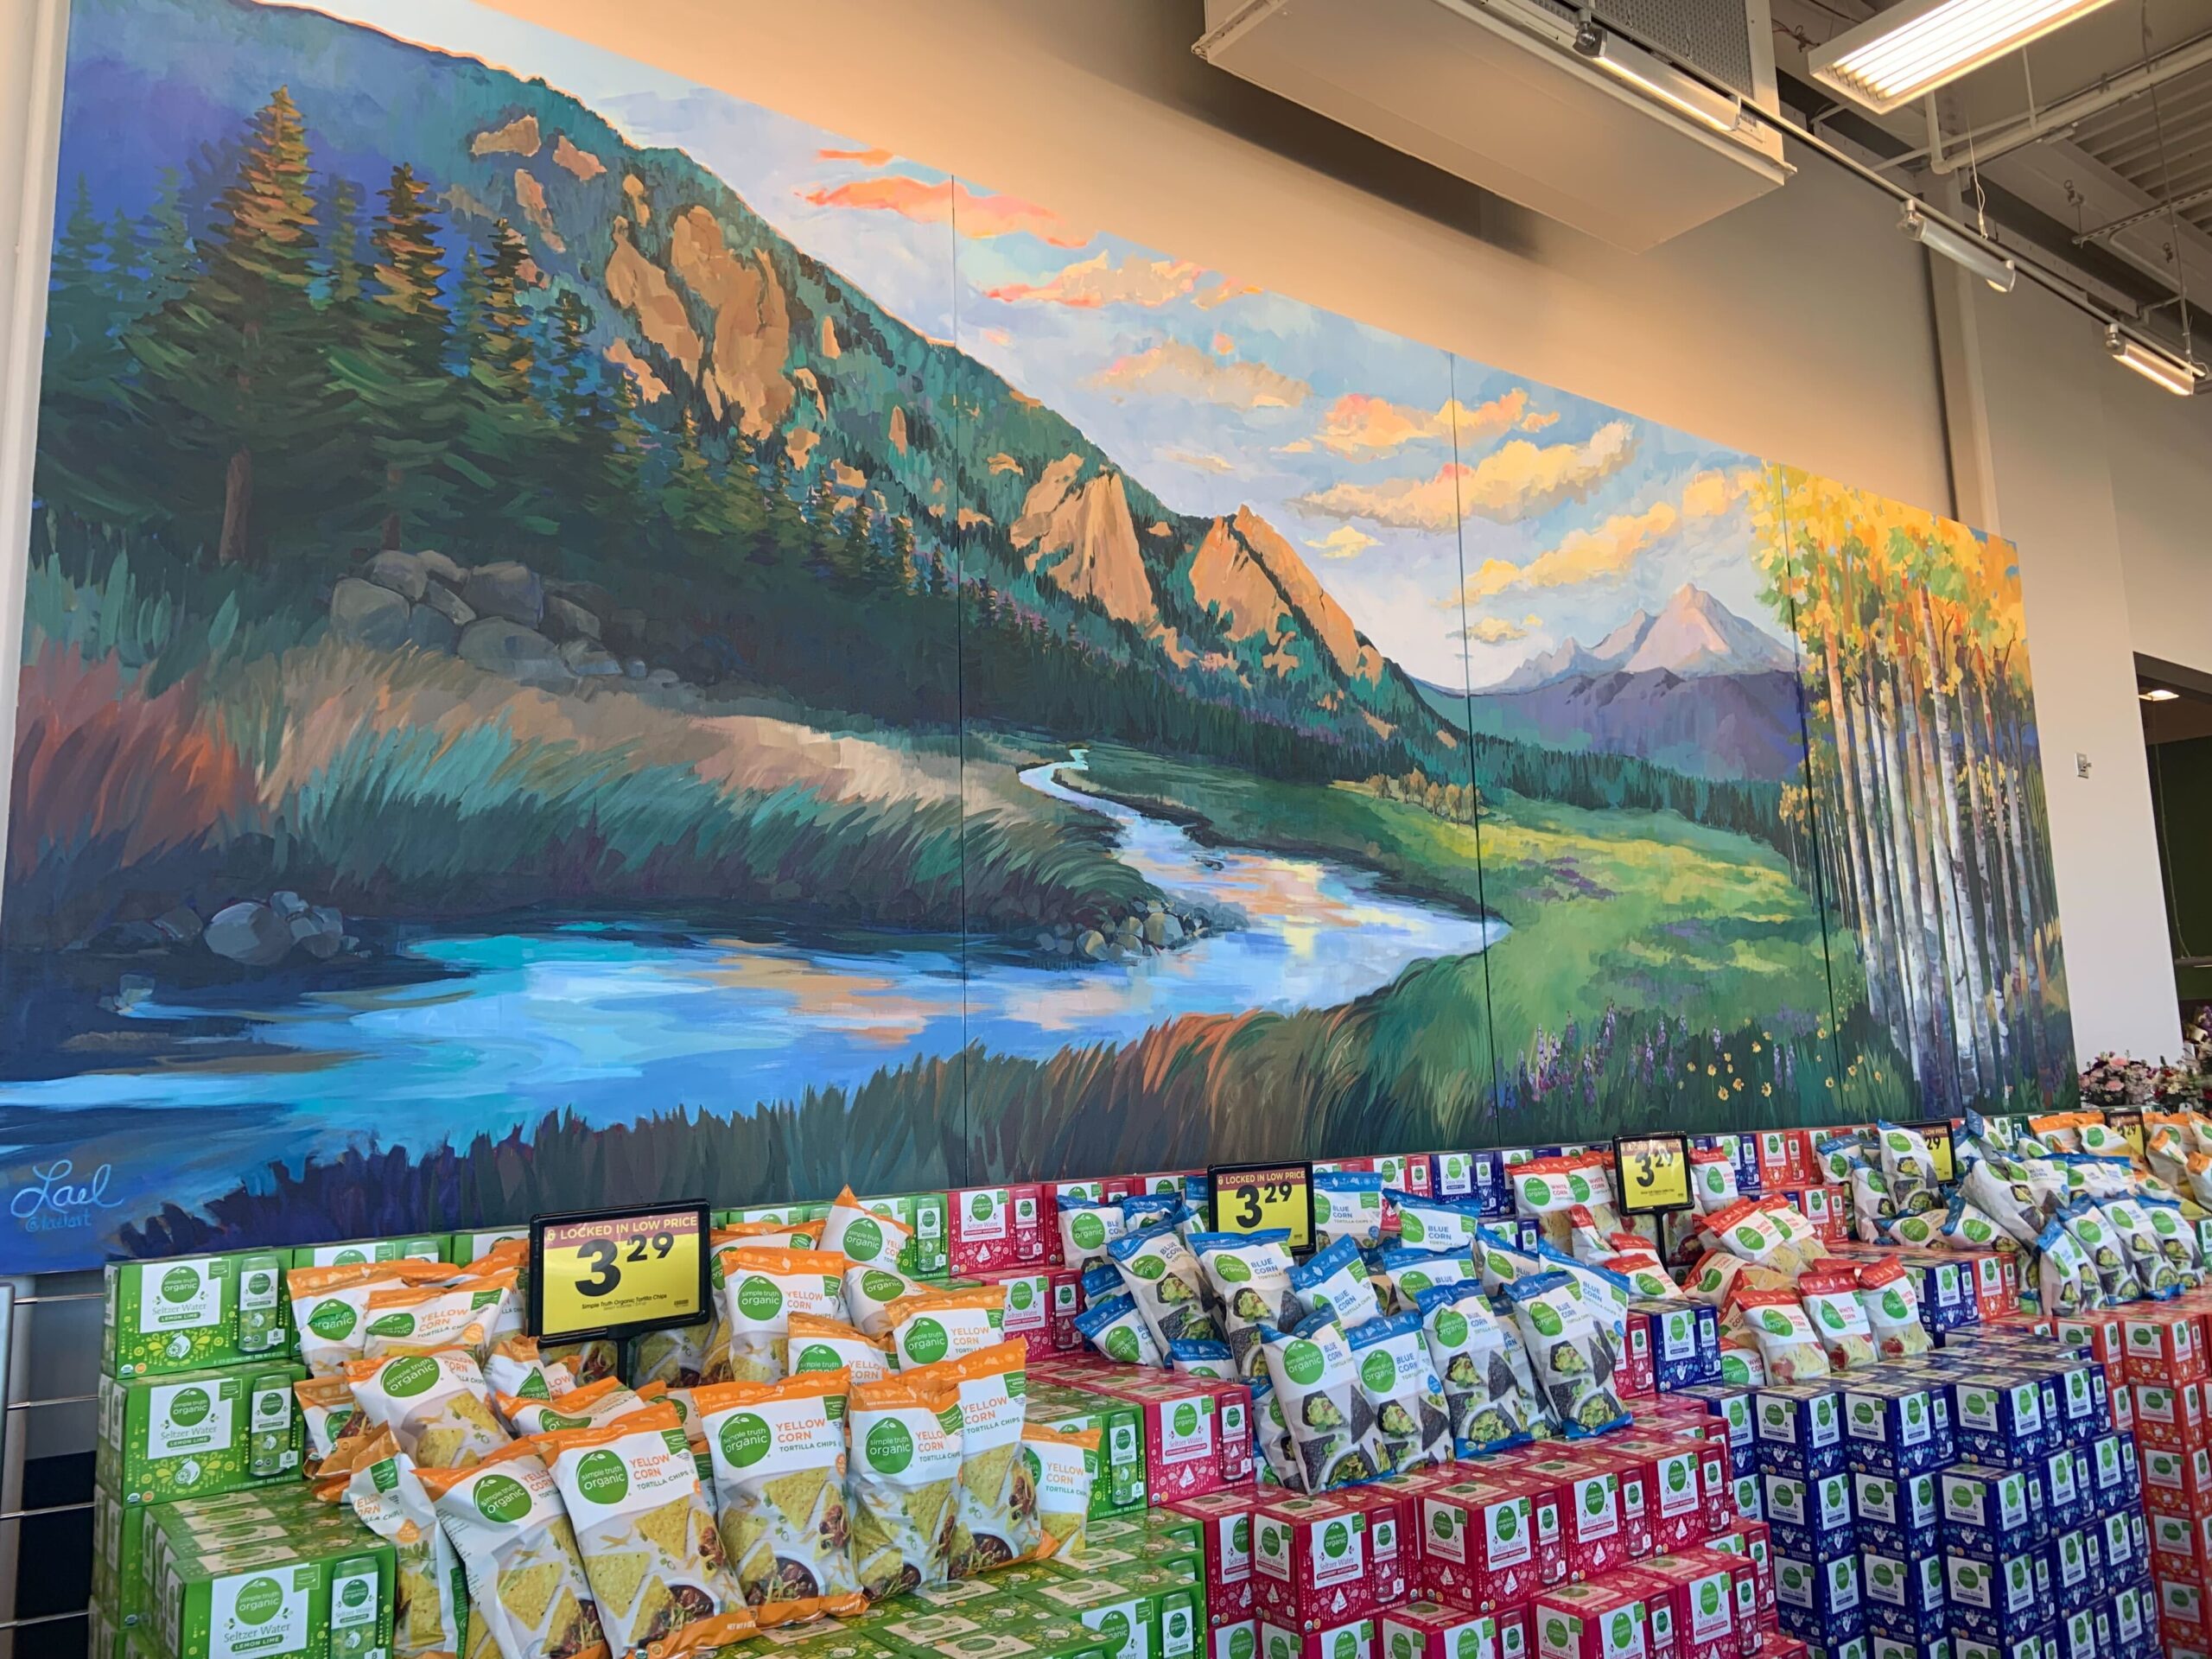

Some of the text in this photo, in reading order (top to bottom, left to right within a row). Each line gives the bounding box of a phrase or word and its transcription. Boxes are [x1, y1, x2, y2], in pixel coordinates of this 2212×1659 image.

[1636, 1152, 1654, 1187] 3
[1226, 1174, 1255, 1185] LOCKED
[1266, 1172, 1283, 1181] LOW
[1285, 1171, 1305, 1179] PRICE
[10, 1160, 124, 1217] Lael
[1236, 1181, 1293, 1228] 3 29
[560, 1217, 698, 1241] LOCKED IN LOW PRICE
[1075, 1228, 1103, 1237] organic
[846, 1236, 880, 1249] organic
[1160, 1241, 1177, 1256] BLUE
[575, 1232, 675, 1297] 3 29
[1251, 1258, 1274, 1268] BLUE
[1255, 1265, 1278, 1274] CORN
[164, 1281, 197, 1292] organic
[867, 1281, 902, 1292] organic
[1582, 1281, 1601, 1295] BLUE
[786, 1291, 823, 1300] YELLOW
[1333, 1290, 1350, 1305] BLUE
[1583, 1287, 1603, 1302] CORN
[741, 1297, 779, 1306] organic
[787, 1300, 811, 1309] CORN
[1338, 1295, 1357, 1312] CORN
[1556, 1302, 1569, 1312] BLUE
[153, 1303, 207, 1314] Seltzer Water
[1561, 1308, 1577, 1318] CORN
[420, 1308, 469, 1323] YELLOW
[312, 1318, 353, 1329] organic
[418, 1319, 450, 1332] CORN
[1438, 1321, 1466, 1335] organic
[1471, 1319, 1488, 1327] CORN
[417, 1325, 450, 1338] TORTILLA
[950, 1326, 989, 1336] YELLOW
[907, 1332, 947, 1344] simple truth
[908, 1337, 946, 1350] organic
[953, 1337, 979, 1345] CORN
[1324, 1342, 1337, 1352] BLUE
[1304, 1351, 1319, 1361] truth
[1327, 1351, 1343, 1362] CORN
[1395, 1353, 1414, 1364] BLUE
[409, 1357, 431, 1370] truth
[823, 1359, 839, 1368] truth
[1288, 1357, 1322, 1374] organic
[1398, 1361, 1418, 1374] CORN
[390, 1362, 435, 1391] organic
[849, 1370, 879, 1379] CORN
[1365, 1367, 1394, 1380] organic
[173, 1404, 207, 1414] organic
[962, 1397, 1007, 1414] YELLOW
[964, 1410, 996, 1425] CORN
[1175, 1417, 1196, 1426] organic
[776, 1418, 825, 1432] YELLOW
[966, 1417, 1020, 1434] TORTILLA CHIPS
[161, 1426, 217, 1440] Seltzer Water
[724, 1427, 766, 1444] simple truth
[778, 1431, 811, 1443] CORN
[169, 1438, 192, 1446] LEMON
[726, 1434, 767, 1453] organic
[779, 1444, 815, 1452] TORTILLA
[869, 1437, 893, 1446] simple
[918, 1441, 944, 1452] CORN
[1169, 1436, 1204, 1448] Seltzer Water
[869, 1443, 911, 1457] organic
[629, 1453, 670, 1468] YELLOW
[919, 1453, 946, 1462] TORTILLA
[582, 1465, 622, 1480] simple truth
[633, 1468, 662, 1480] CORN
[1046, 1462, 1084, 1476] YELLOW
[584, 1472, 625, 1490] organic
[637, 1471, 689, 1491] TORTILLA CHIPS
[1046, 1472, 1074, 1484] CORN
[480, 1483, 518, 1507] simple truth
[1046, 1486, 1075, 1495] TORTILLA
[487, 1489, 525, 1514] organic
[1325, 1537, 1347, 1548] organic
[1493, 1545, 1508, 1554] Seltzer
[1319, 1559, 1354, 1571] Seltzer Water
[261, 1591, 280, 1600] truth
[238, 1597, 279, 1612] organic
[224, 1623, 290, 1643] Seltzer Water
[235, 1636, 280, 1650] LEMON LIME
